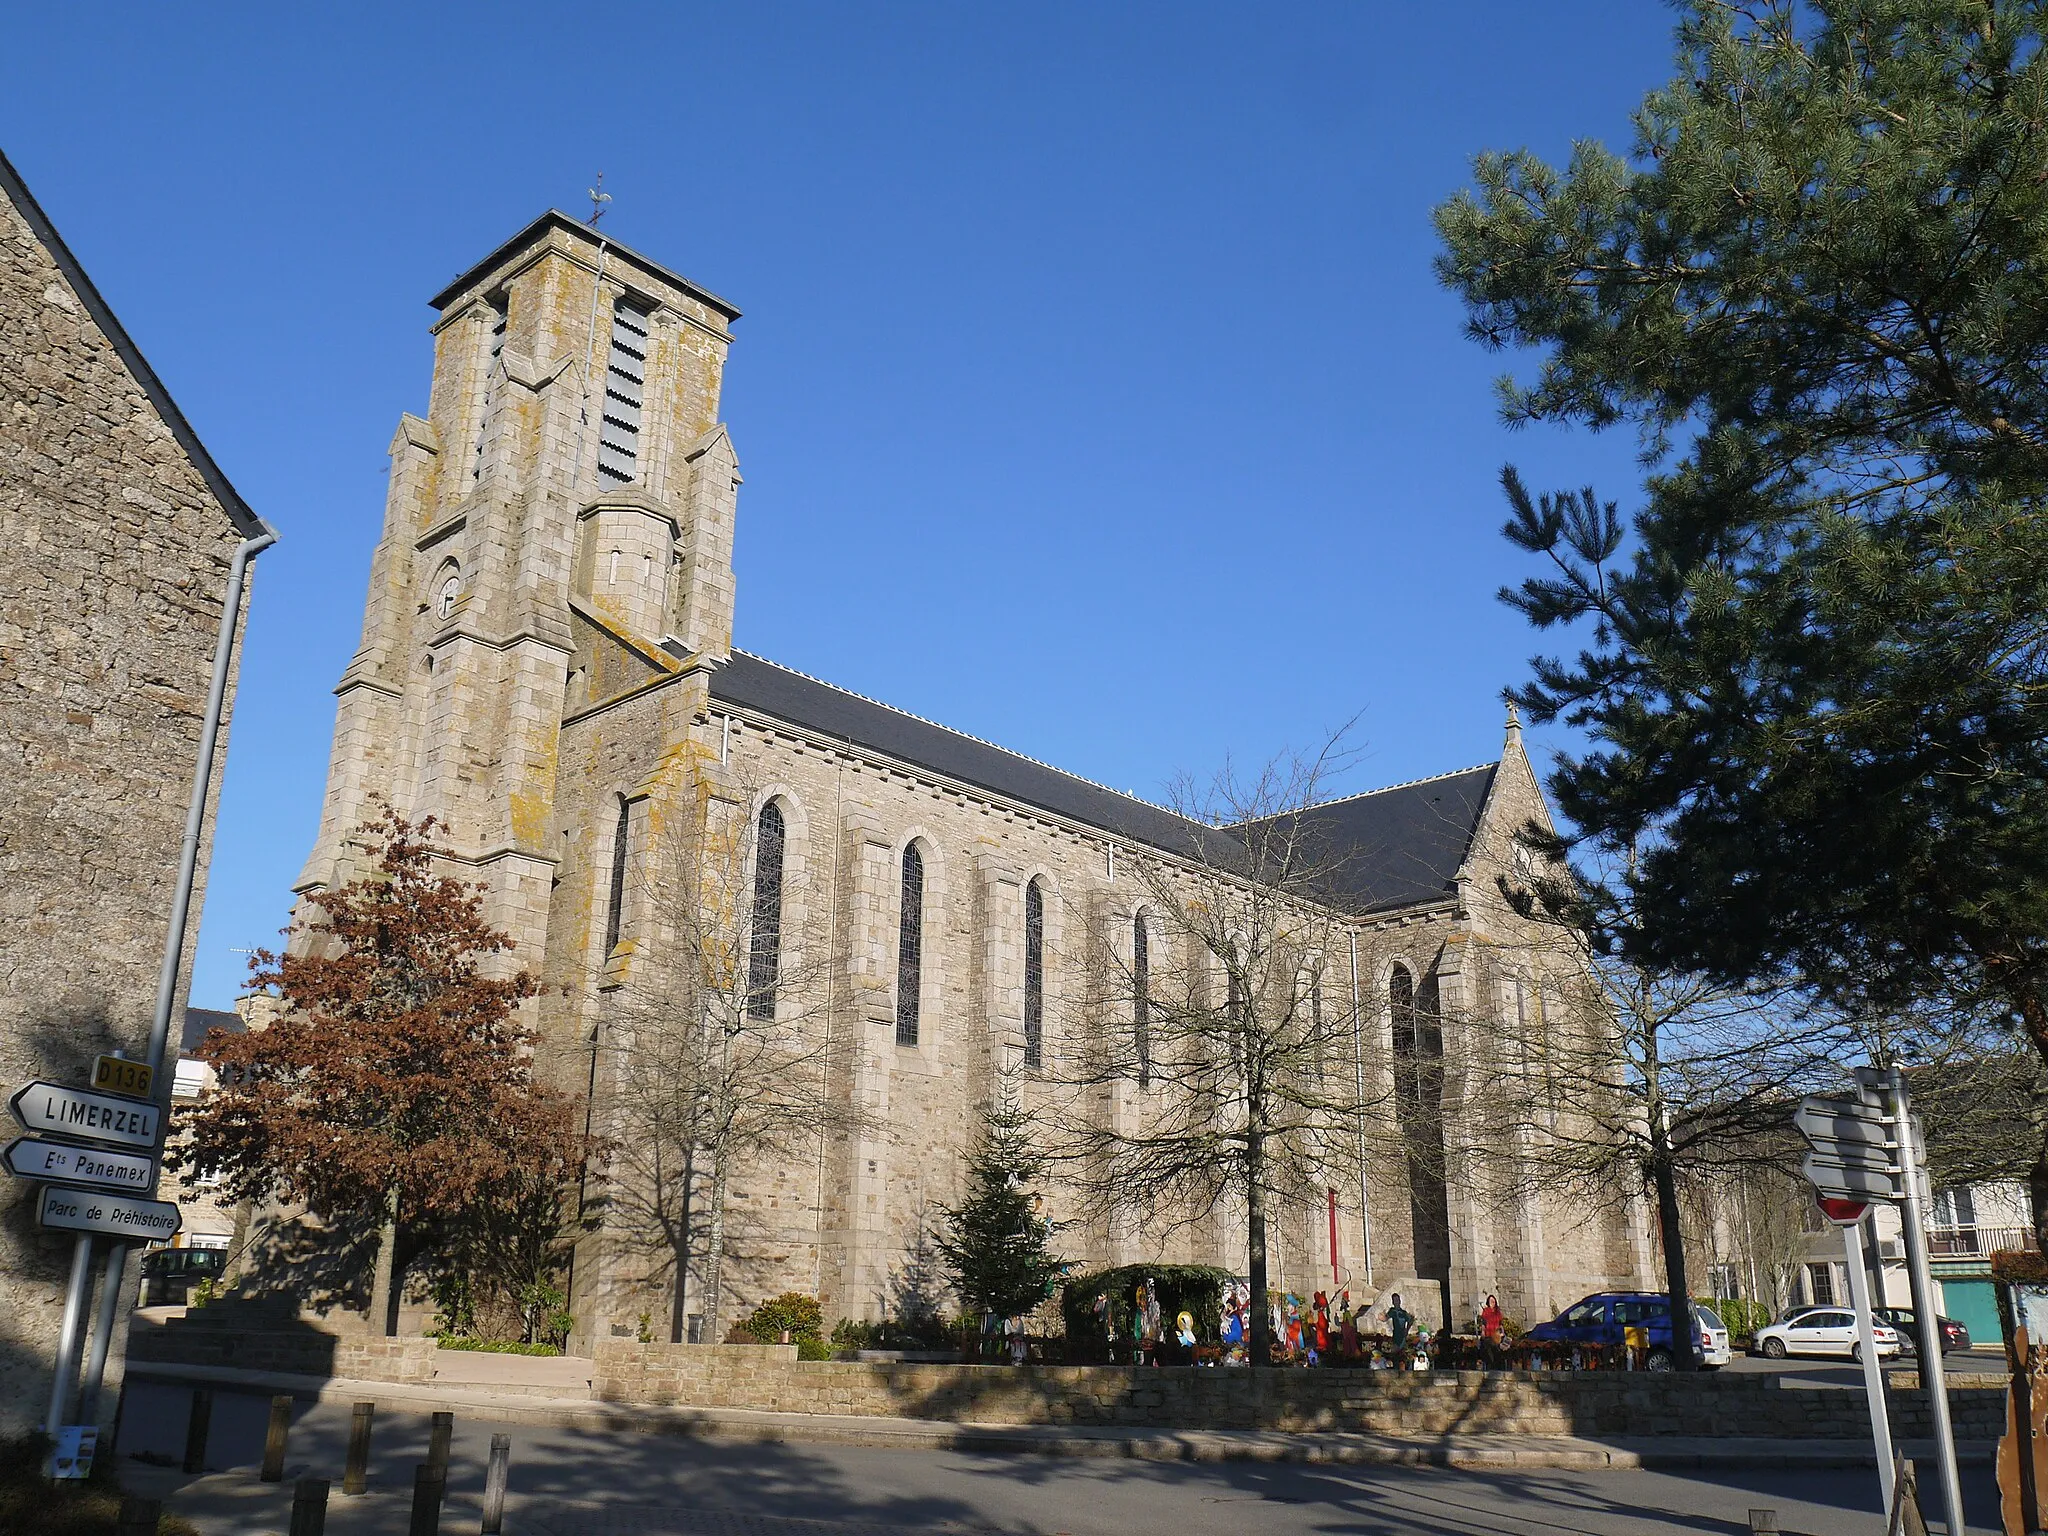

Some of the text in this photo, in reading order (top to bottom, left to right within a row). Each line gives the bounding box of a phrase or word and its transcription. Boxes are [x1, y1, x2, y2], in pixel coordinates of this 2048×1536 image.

[45, 1097, 150, 1136] LIMERZEL
[75, 1156, 146, 1181] Panemex
[47, 1200, 174, 1228] Parc de Préhistoire
